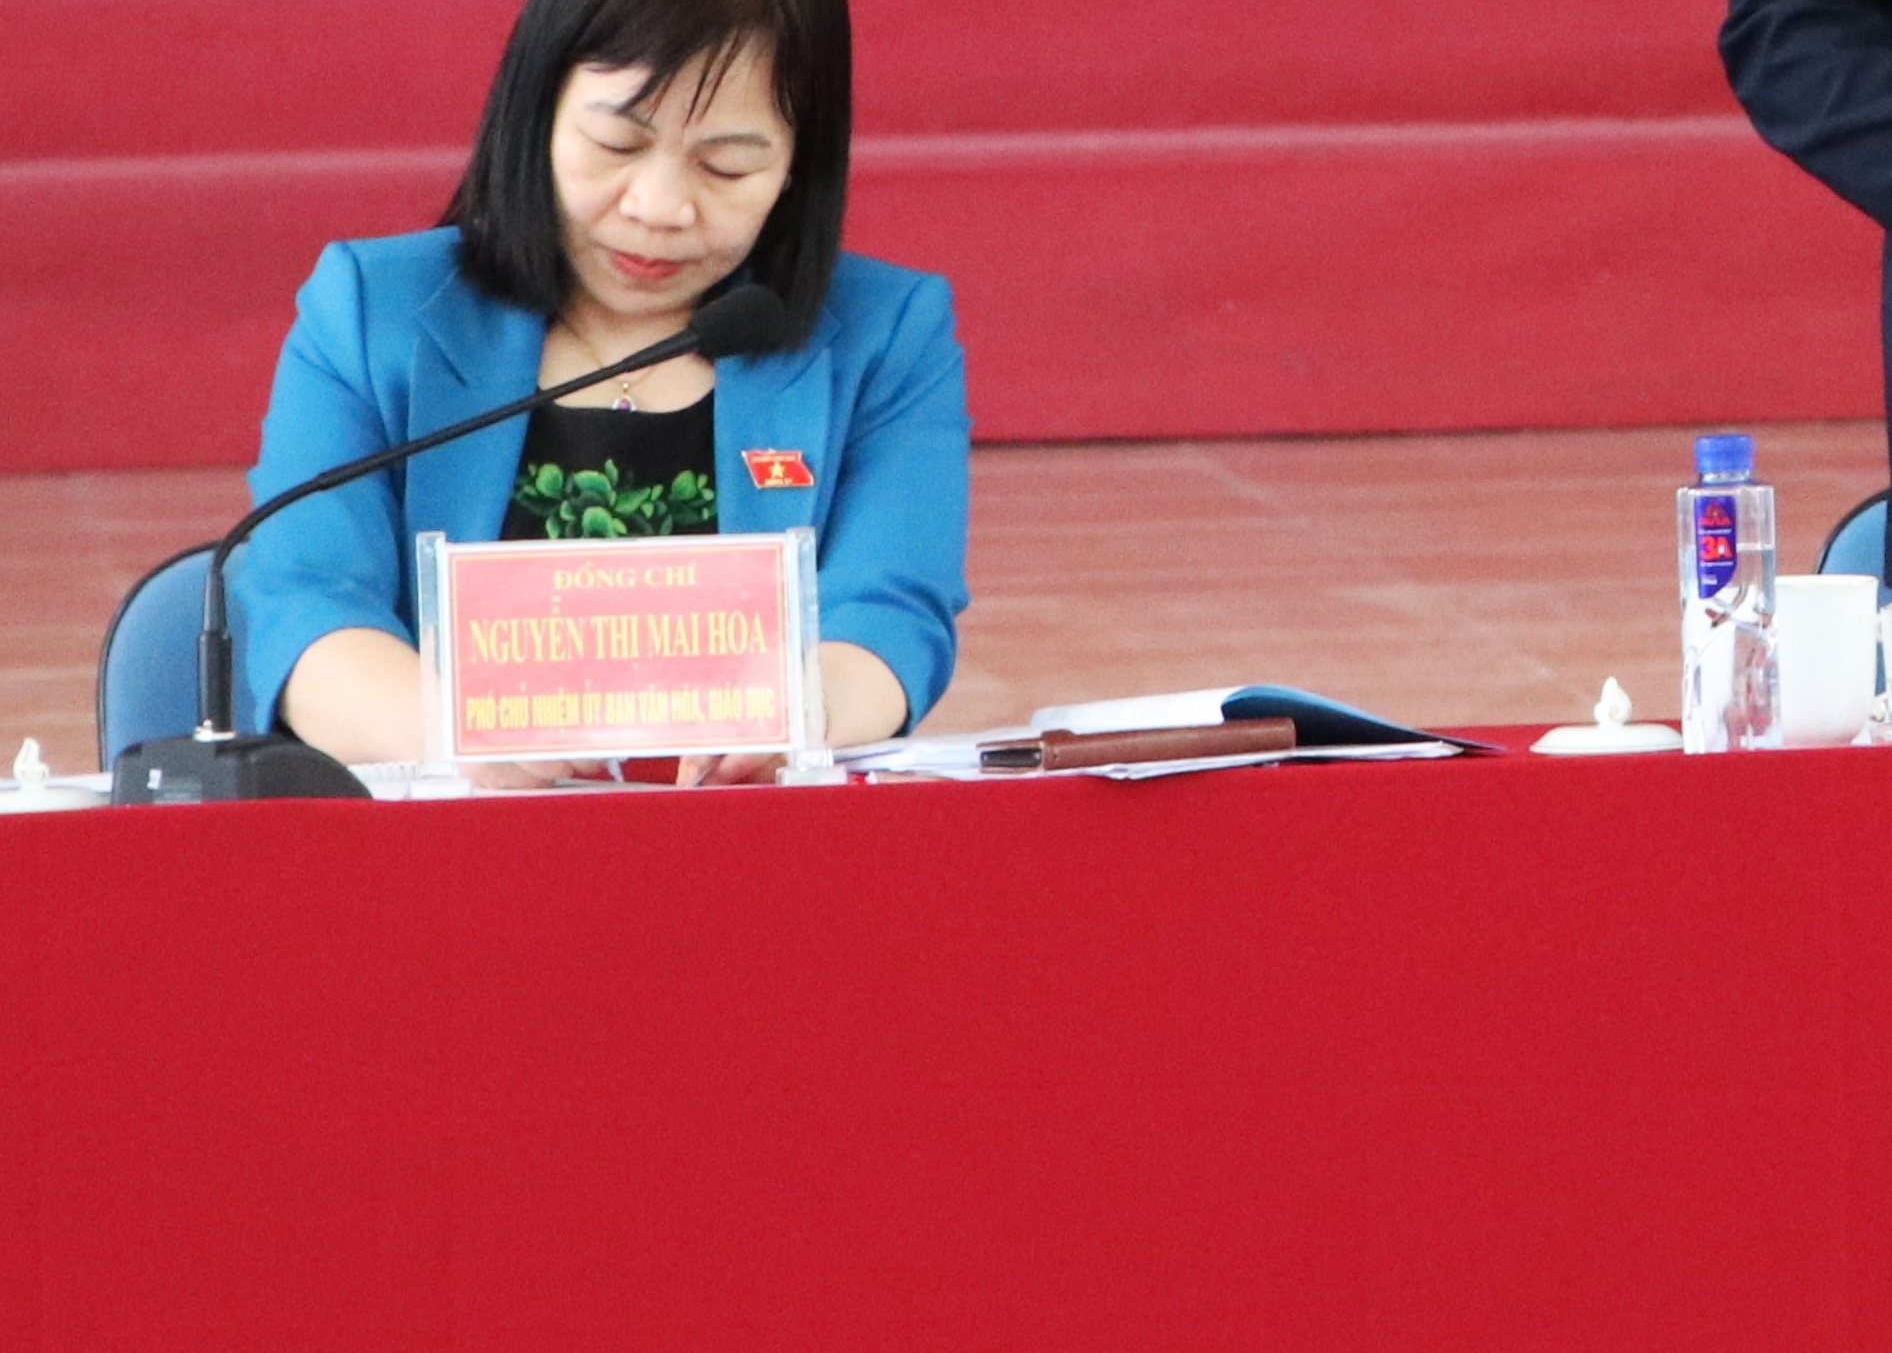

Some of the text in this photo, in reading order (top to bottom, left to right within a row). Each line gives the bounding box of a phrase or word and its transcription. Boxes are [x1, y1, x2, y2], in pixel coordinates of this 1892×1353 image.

[553, 561, 696, 590] ĐỒNG CHÍ
[470, 595, 768, 670] NGUYỄN THỊ MAI HOA
